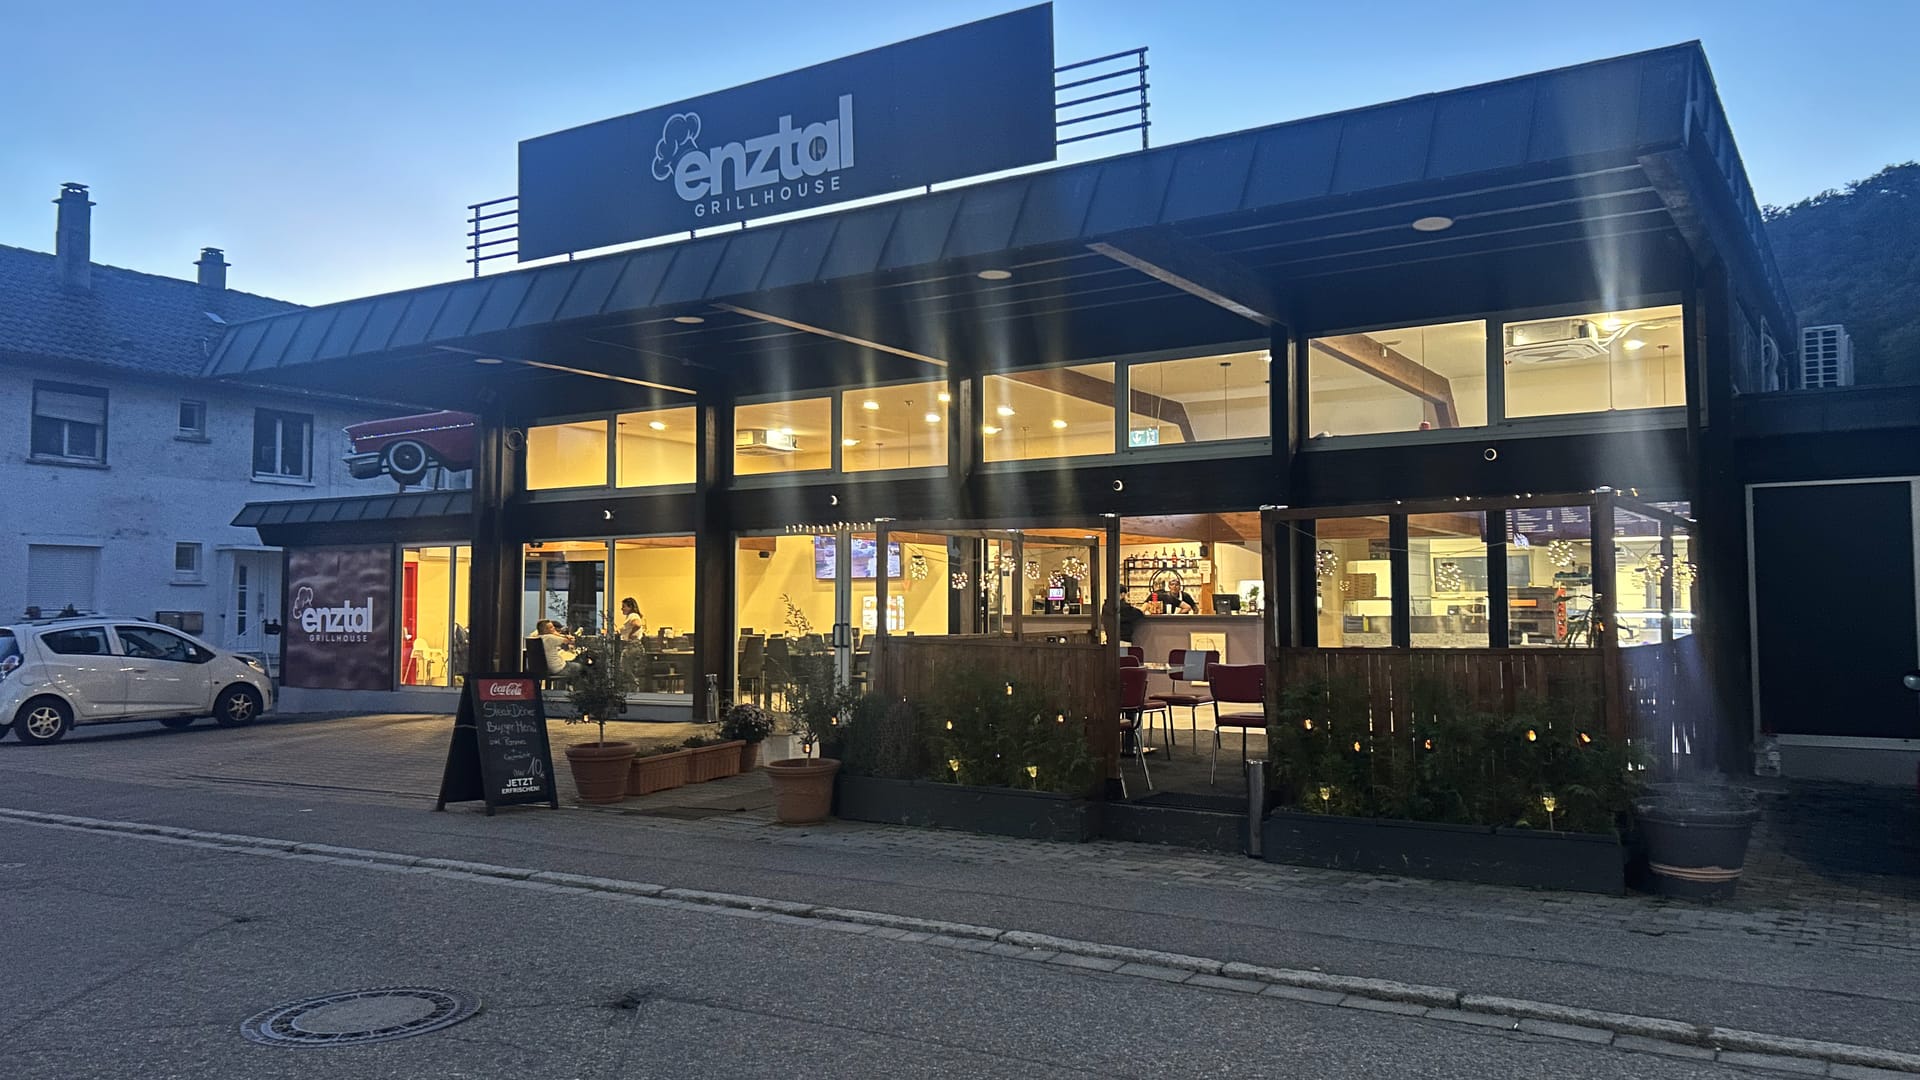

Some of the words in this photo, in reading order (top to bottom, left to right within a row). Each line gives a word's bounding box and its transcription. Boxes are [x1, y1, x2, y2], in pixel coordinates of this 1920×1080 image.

[674, 94, 854, 201] enztal
[694, 176, 841, 217] GRILLHOUSE
[302, 597, 374, 633] enztal
[309, 634, 368, 642] GRILLHOUSE
[506, 777, 534, 787] JETZT
